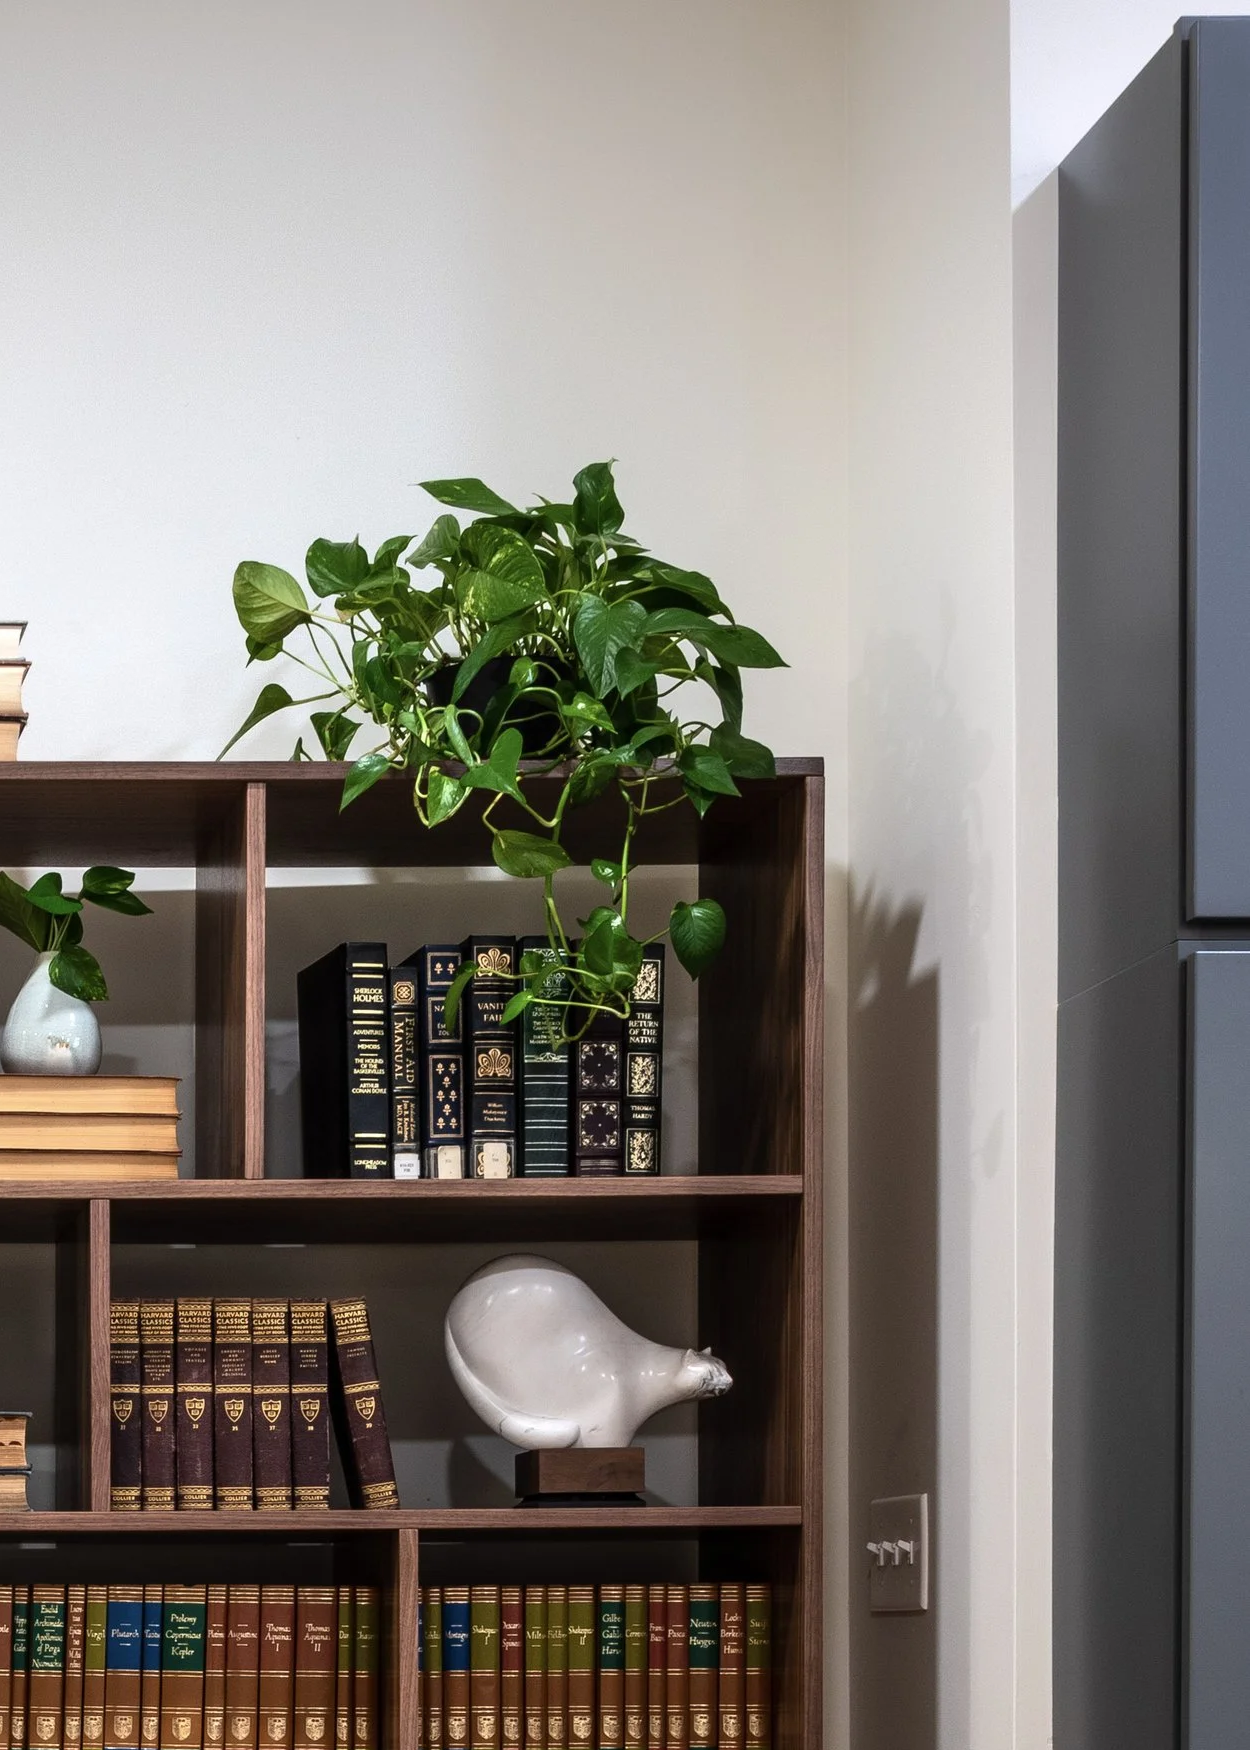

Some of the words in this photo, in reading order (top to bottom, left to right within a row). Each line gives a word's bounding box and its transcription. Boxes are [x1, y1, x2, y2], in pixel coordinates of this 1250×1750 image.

[353, 995, 384, 1003] HOLMES
[636, 1012, 653, 1020] THE
[628, 1020, 659, 1028] RETURN
[405, 1017, 415, 1054] FIRST
[629, 1028, 640, 1036] OF
[641, 1028, 657, 1036] THE
[394, 1021, 405, 1080] MANUAL
[406, 1058, 416, 1083] AID
[334, 1310, 367, 1320] HARVARD
[335, 1316, 368, 1326] CLASSICS
[170, 1614, 197, 1625] Ptolemy
[86, 1629, 106, 1641] Virgil
[111, 1629, 140, 1638] Plutarch
[171, 1647, 194, 1659] Kepler
